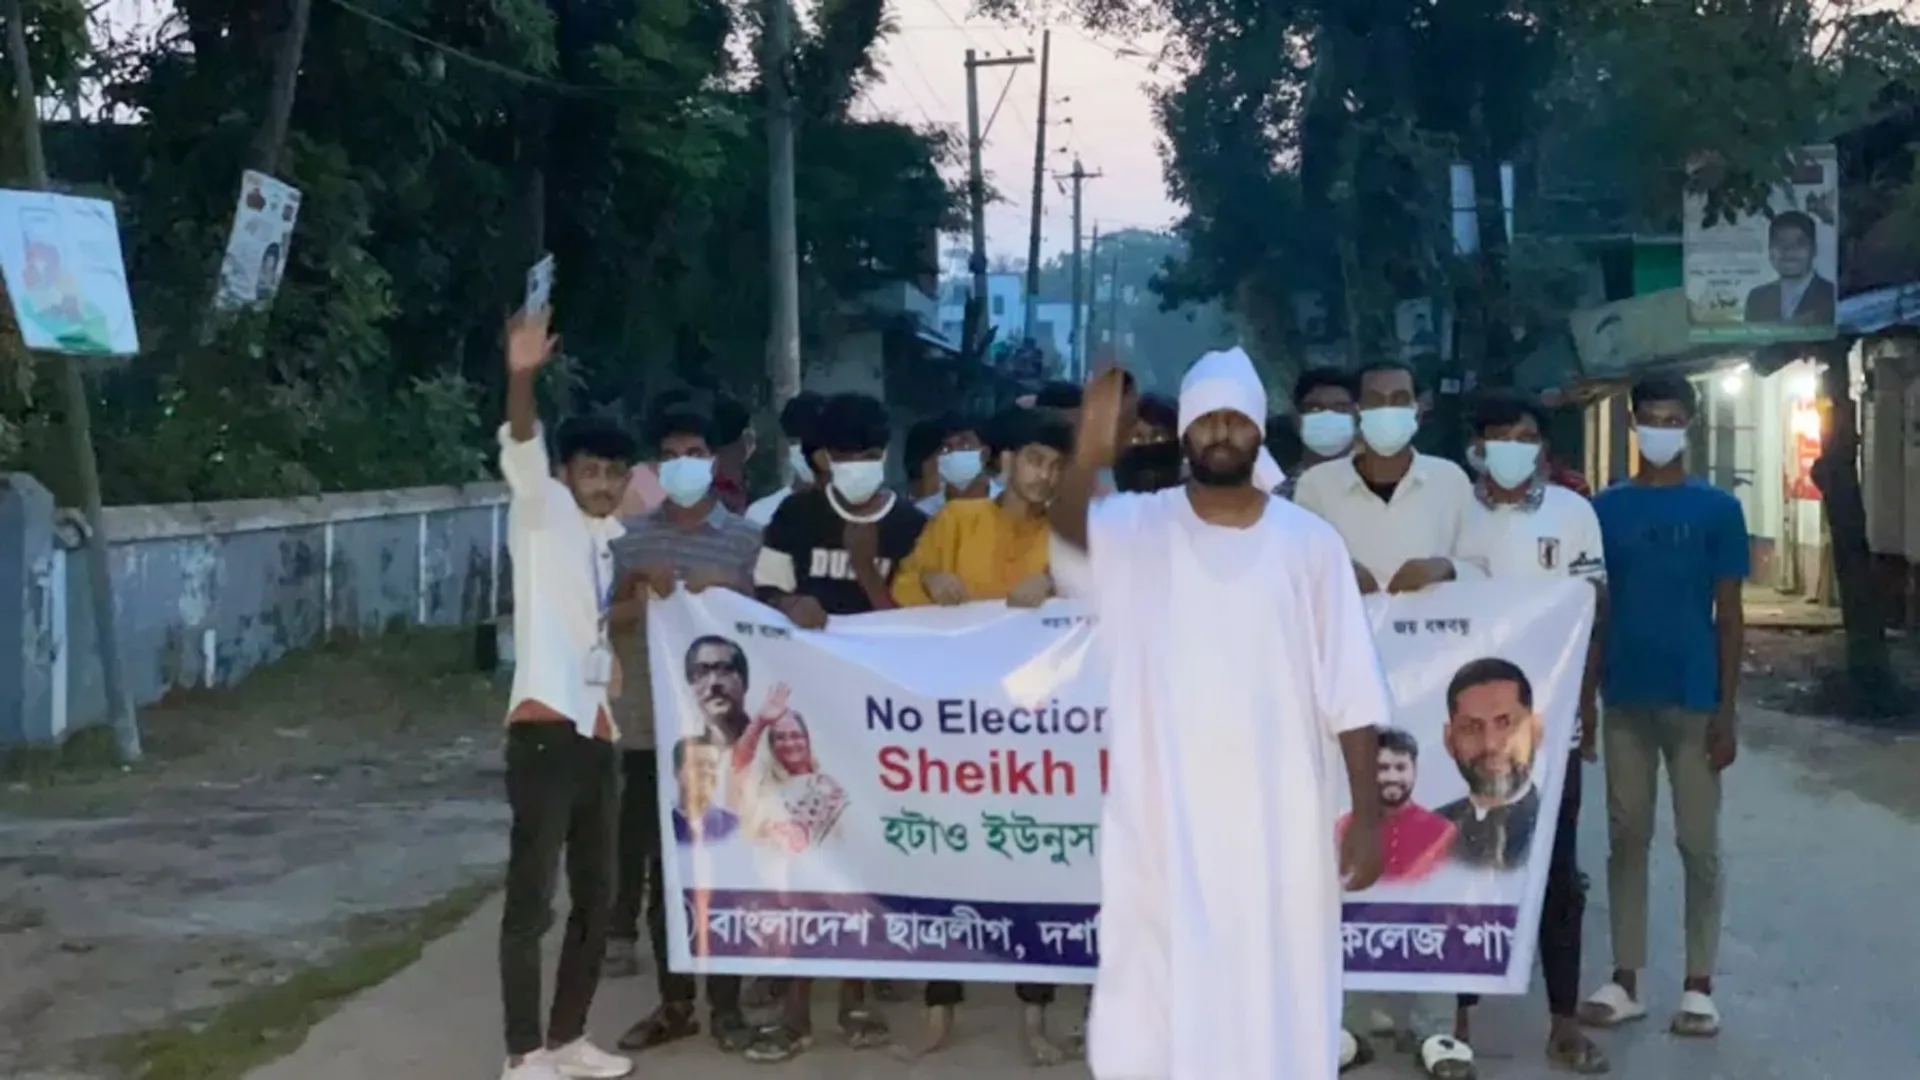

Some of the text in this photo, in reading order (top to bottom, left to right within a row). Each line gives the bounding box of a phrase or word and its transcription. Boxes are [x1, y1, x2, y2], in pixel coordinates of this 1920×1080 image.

[865, 695, 923, 732] No
[877, 745, 1076, 796] Sheikh
[880, 807, 1098, 867] হটাও ইউনুস
[709, 905, 872, 950] বাংলাদেশ
[884, 904, 1027, 960] ছাত্রলীগ,
[1341, 922, 1449, 961] কলেজ
